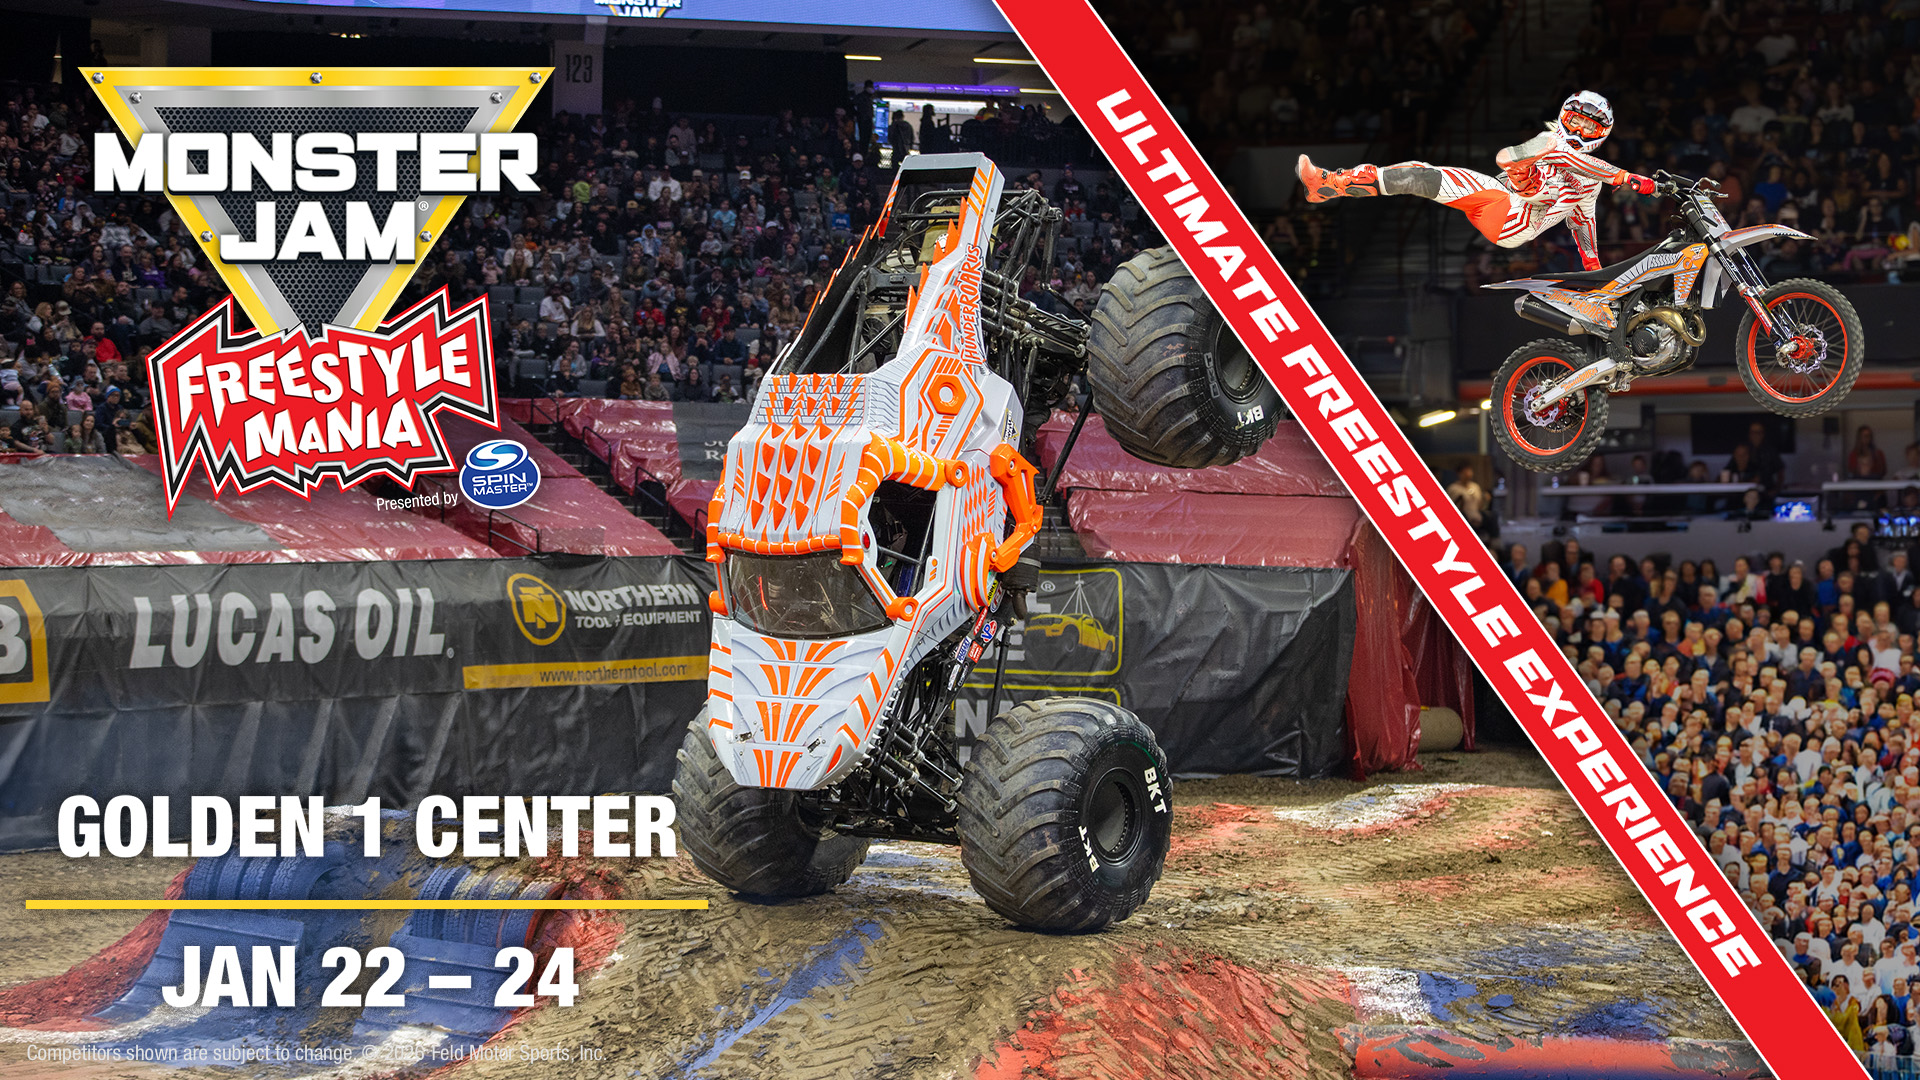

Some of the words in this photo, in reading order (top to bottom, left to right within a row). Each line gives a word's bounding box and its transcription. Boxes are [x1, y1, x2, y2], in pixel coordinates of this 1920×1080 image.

[618, 5, 658, 18] JAM
[565, 54, 593, 83] 123
[563, 583, 699, 613] NORTHERN
[129, 590, 337, 669] LUCAS
[575, 615, 612, 629] TOOL
[623, 611, 702, 626] EQUIPMENT
[981, 623, 993, 640] VP
[539, 662, 688, 683] www.northerntool.com
[1144, 766, 1167, 813] BKT
[1078, 826, 1100, 873] BKT
